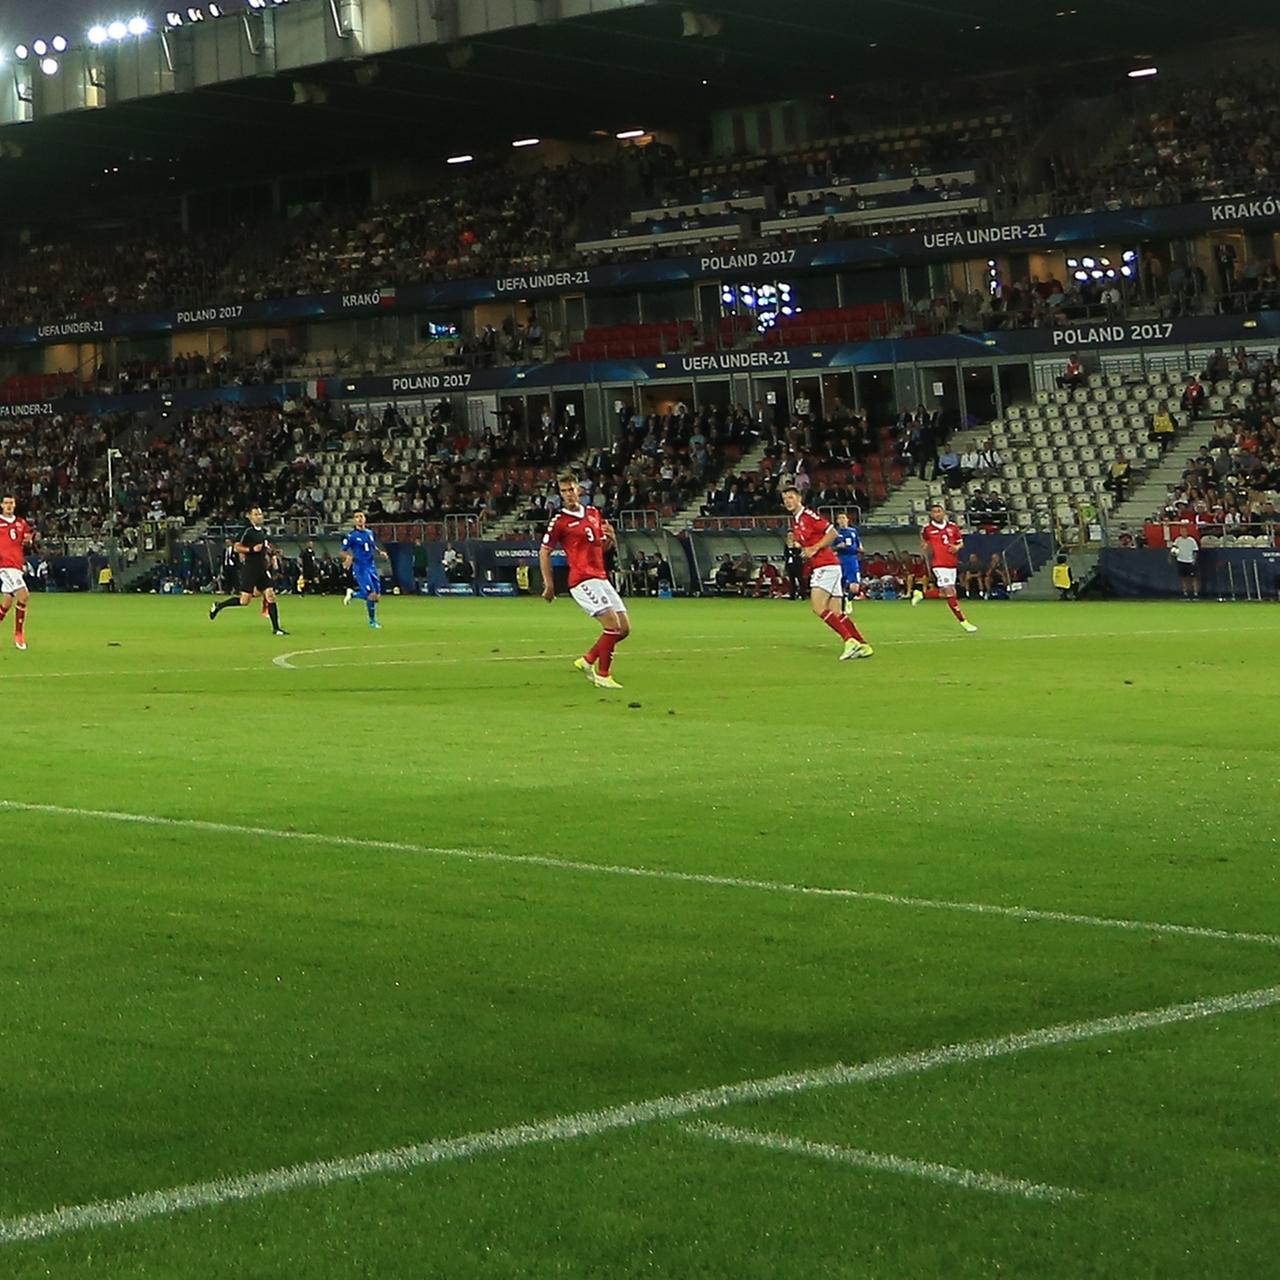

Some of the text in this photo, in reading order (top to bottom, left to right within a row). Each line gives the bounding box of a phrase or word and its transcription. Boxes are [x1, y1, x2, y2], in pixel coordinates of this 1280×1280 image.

[1211, 197, 1280, 221] KRAKÓ
[923, 223, 1047, 249] UEFA UNDER-21
[700, 249, 797, 271] POLAND 2017
[496, 270, 590, 292] UEFA UNDER-21
[342, 290, 381, 308] KRAKÓ
[176, 305, 243, 323] POLAND 2017
[38, 320, 104, 337] UEFA UNDER-21
[1052, 322, 1174, 347] POLAND 2017
[682, 351, 791, 372] UEFA UNDER-21
[392, 373, 472, 391] POLAND 2017
[11, 403, 54, 417] UNDER-21
[8, 528, 17, 541] 6
[584, 526, 595, 542] 3
